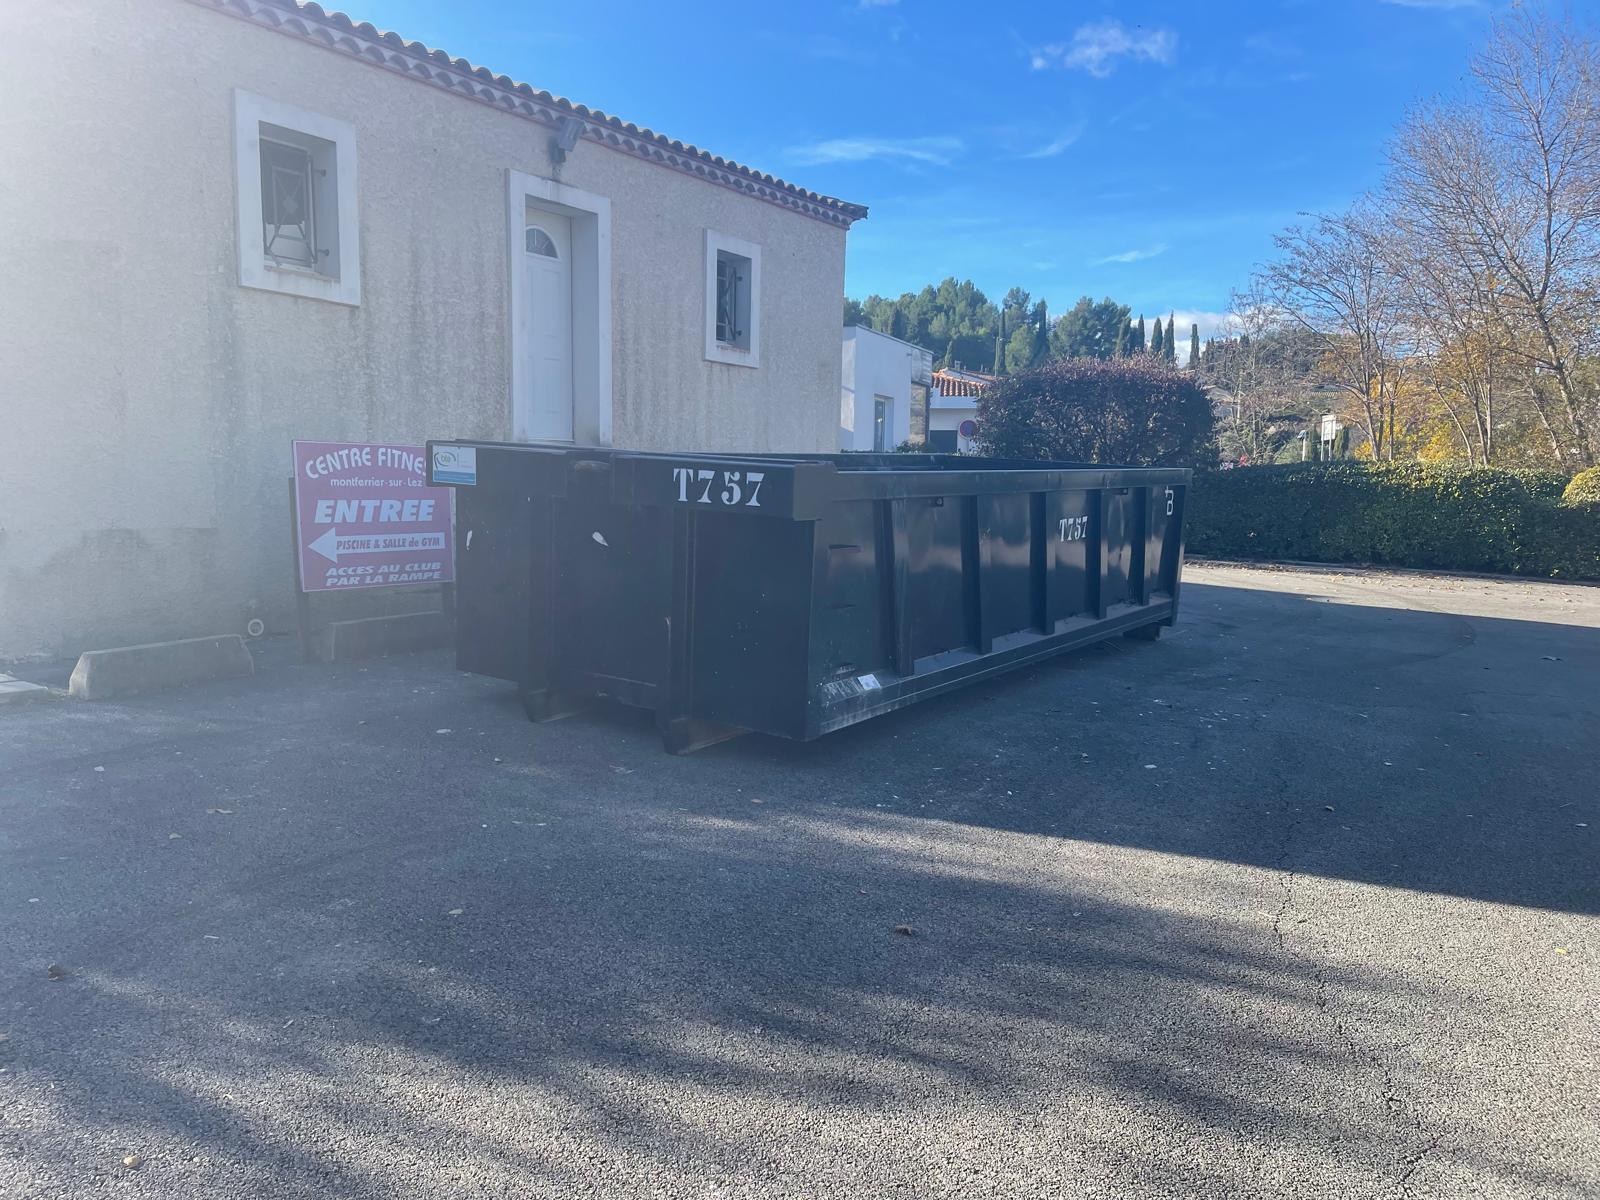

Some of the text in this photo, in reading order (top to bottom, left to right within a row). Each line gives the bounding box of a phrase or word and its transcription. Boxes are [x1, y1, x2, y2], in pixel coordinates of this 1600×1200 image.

[305, 447, 427, 479] CENTRE FITNE
[673, 468, 765, 507] T757
[314, 499, 435, 524] ENTREE
[1059, 516, 1088, 542] T757
[336, 537, 440, 551] PISCINE & SALLE de GYM
[325, 561, 442, 577] ACCES AU CLUB
[325, 571, 442, 587] PAR LA RAMPE
